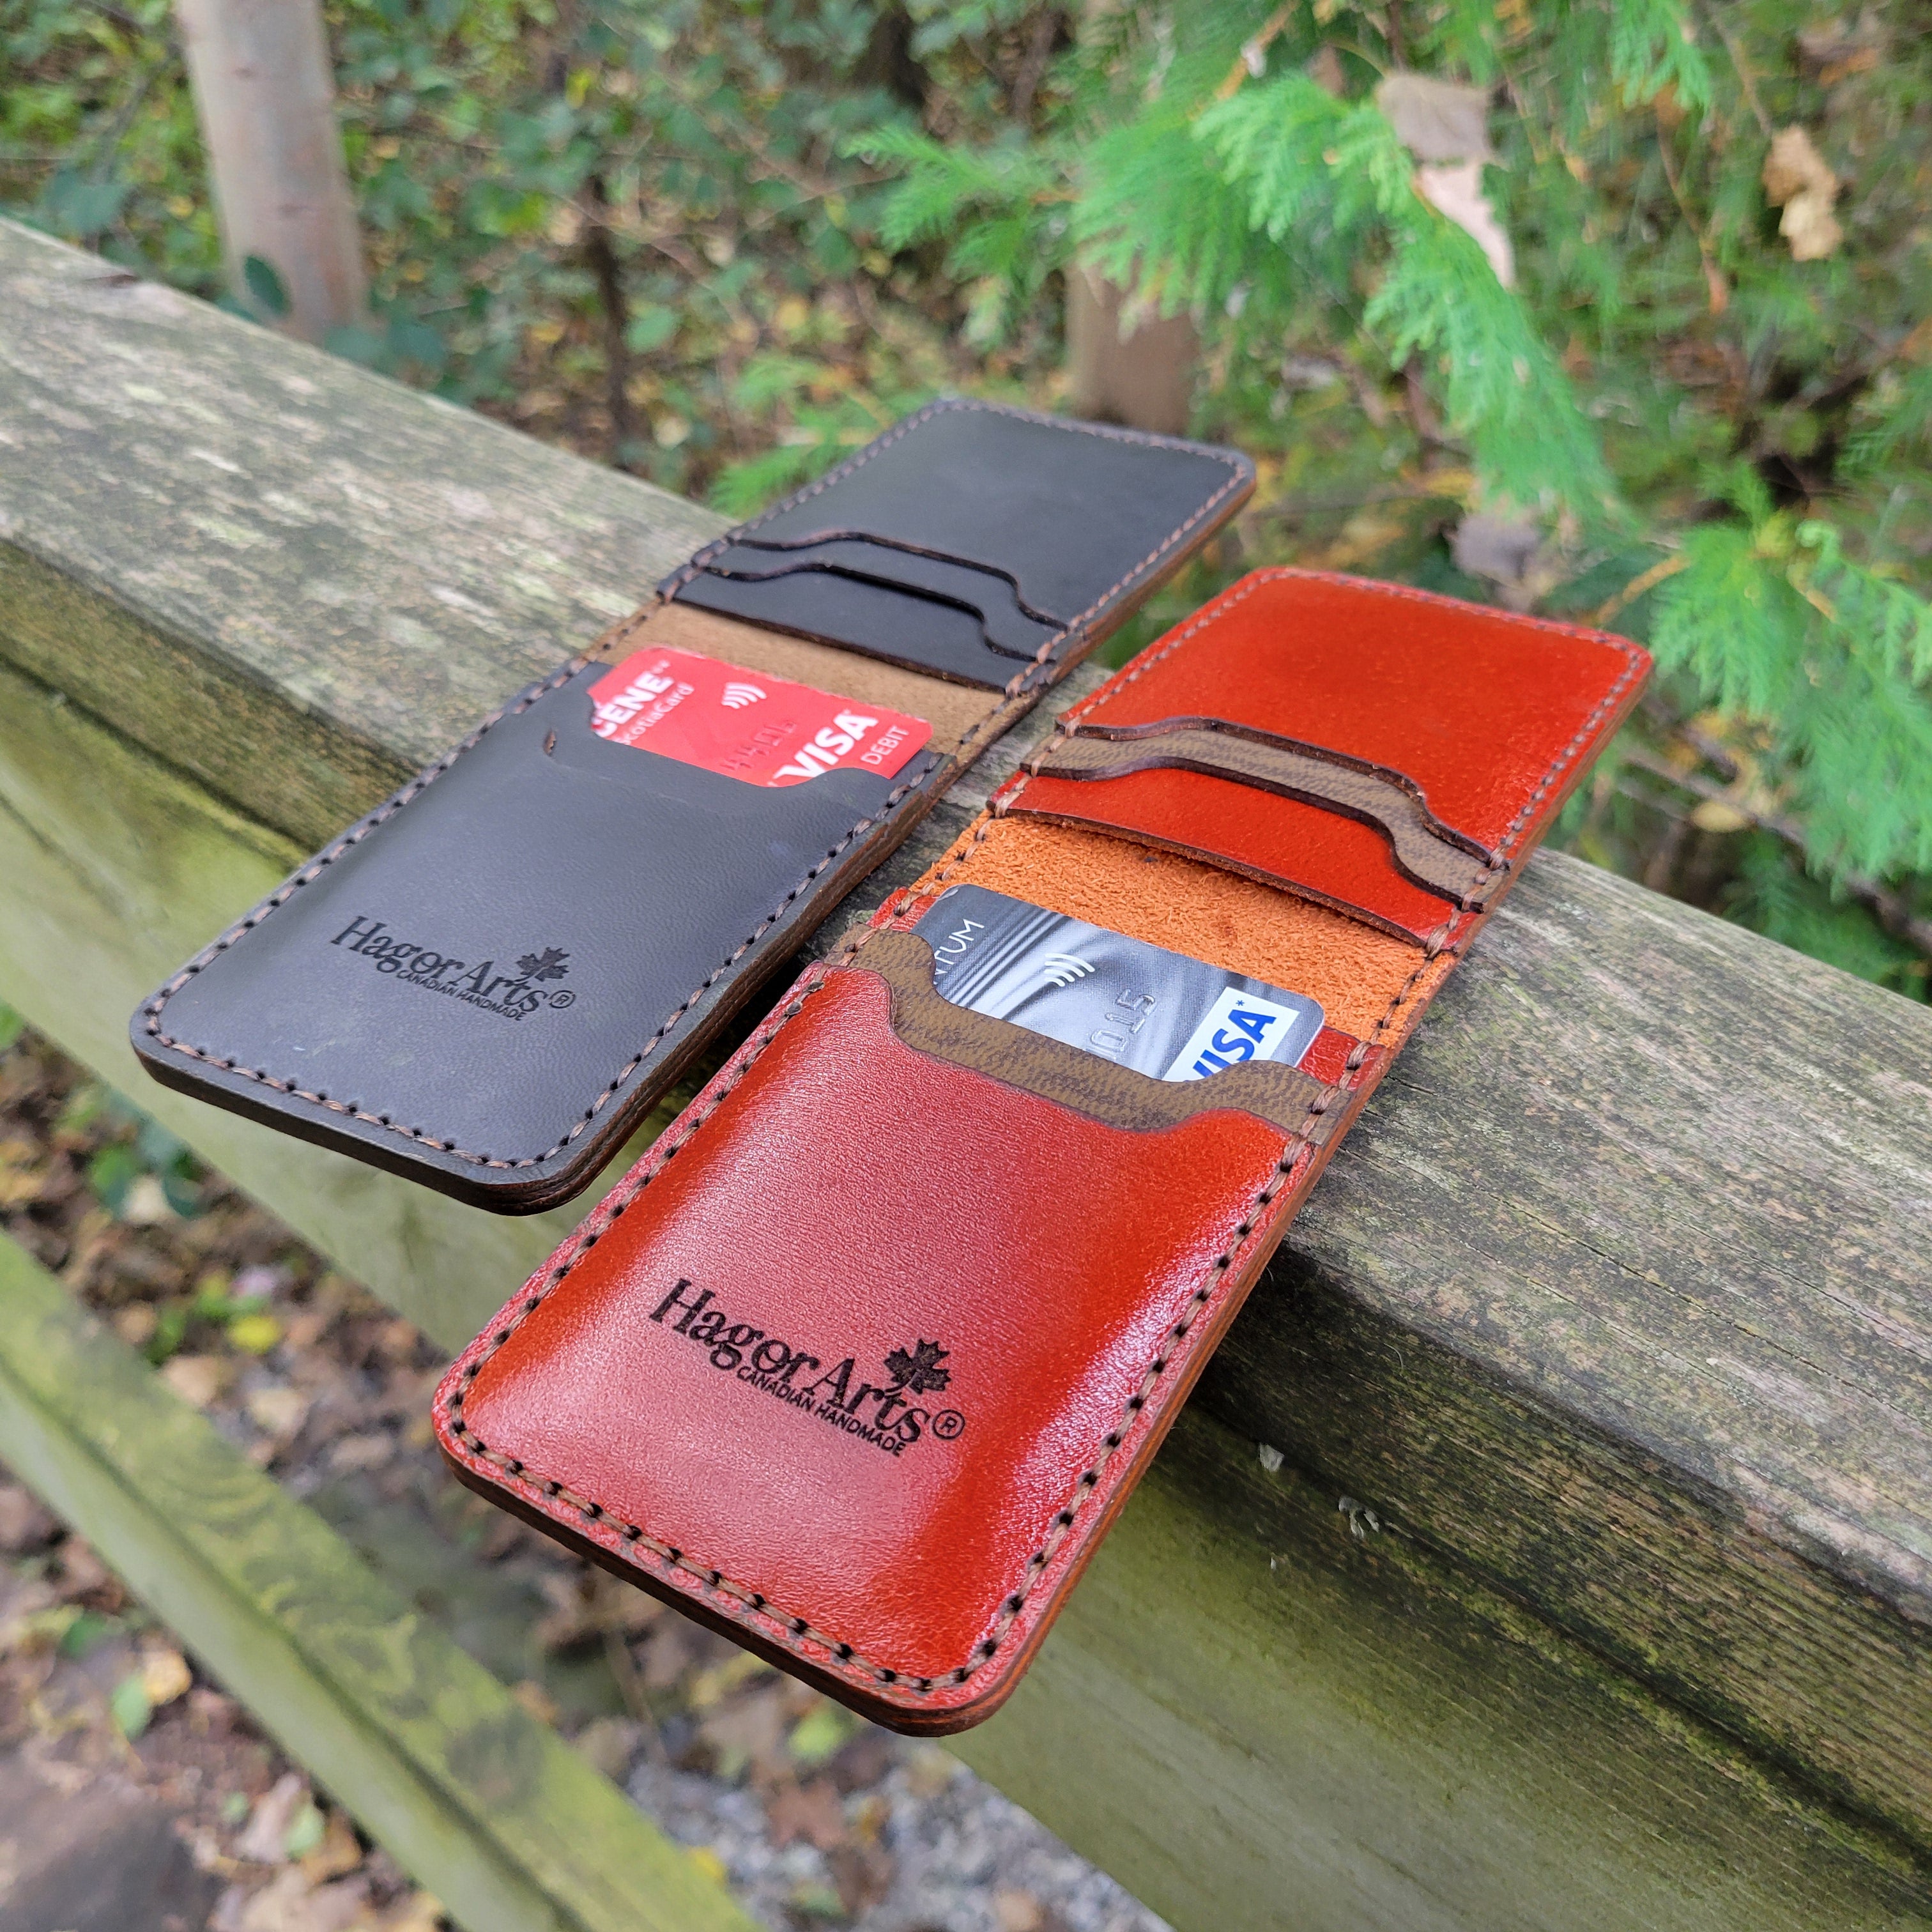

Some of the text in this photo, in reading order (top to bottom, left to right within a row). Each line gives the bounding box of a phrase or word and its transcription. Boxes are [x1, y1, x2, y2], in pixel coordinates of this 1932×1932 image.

[772, 710, 879, 779] VISA
[861, 726, 909, 765] DEBIT
[397, 969, 527, 1022] CANADIAN HANDMADE
[1192, 1009, 1277, 1078] ISA
[737, 1365, 907, 1457] CANADIAN HANDMADE
